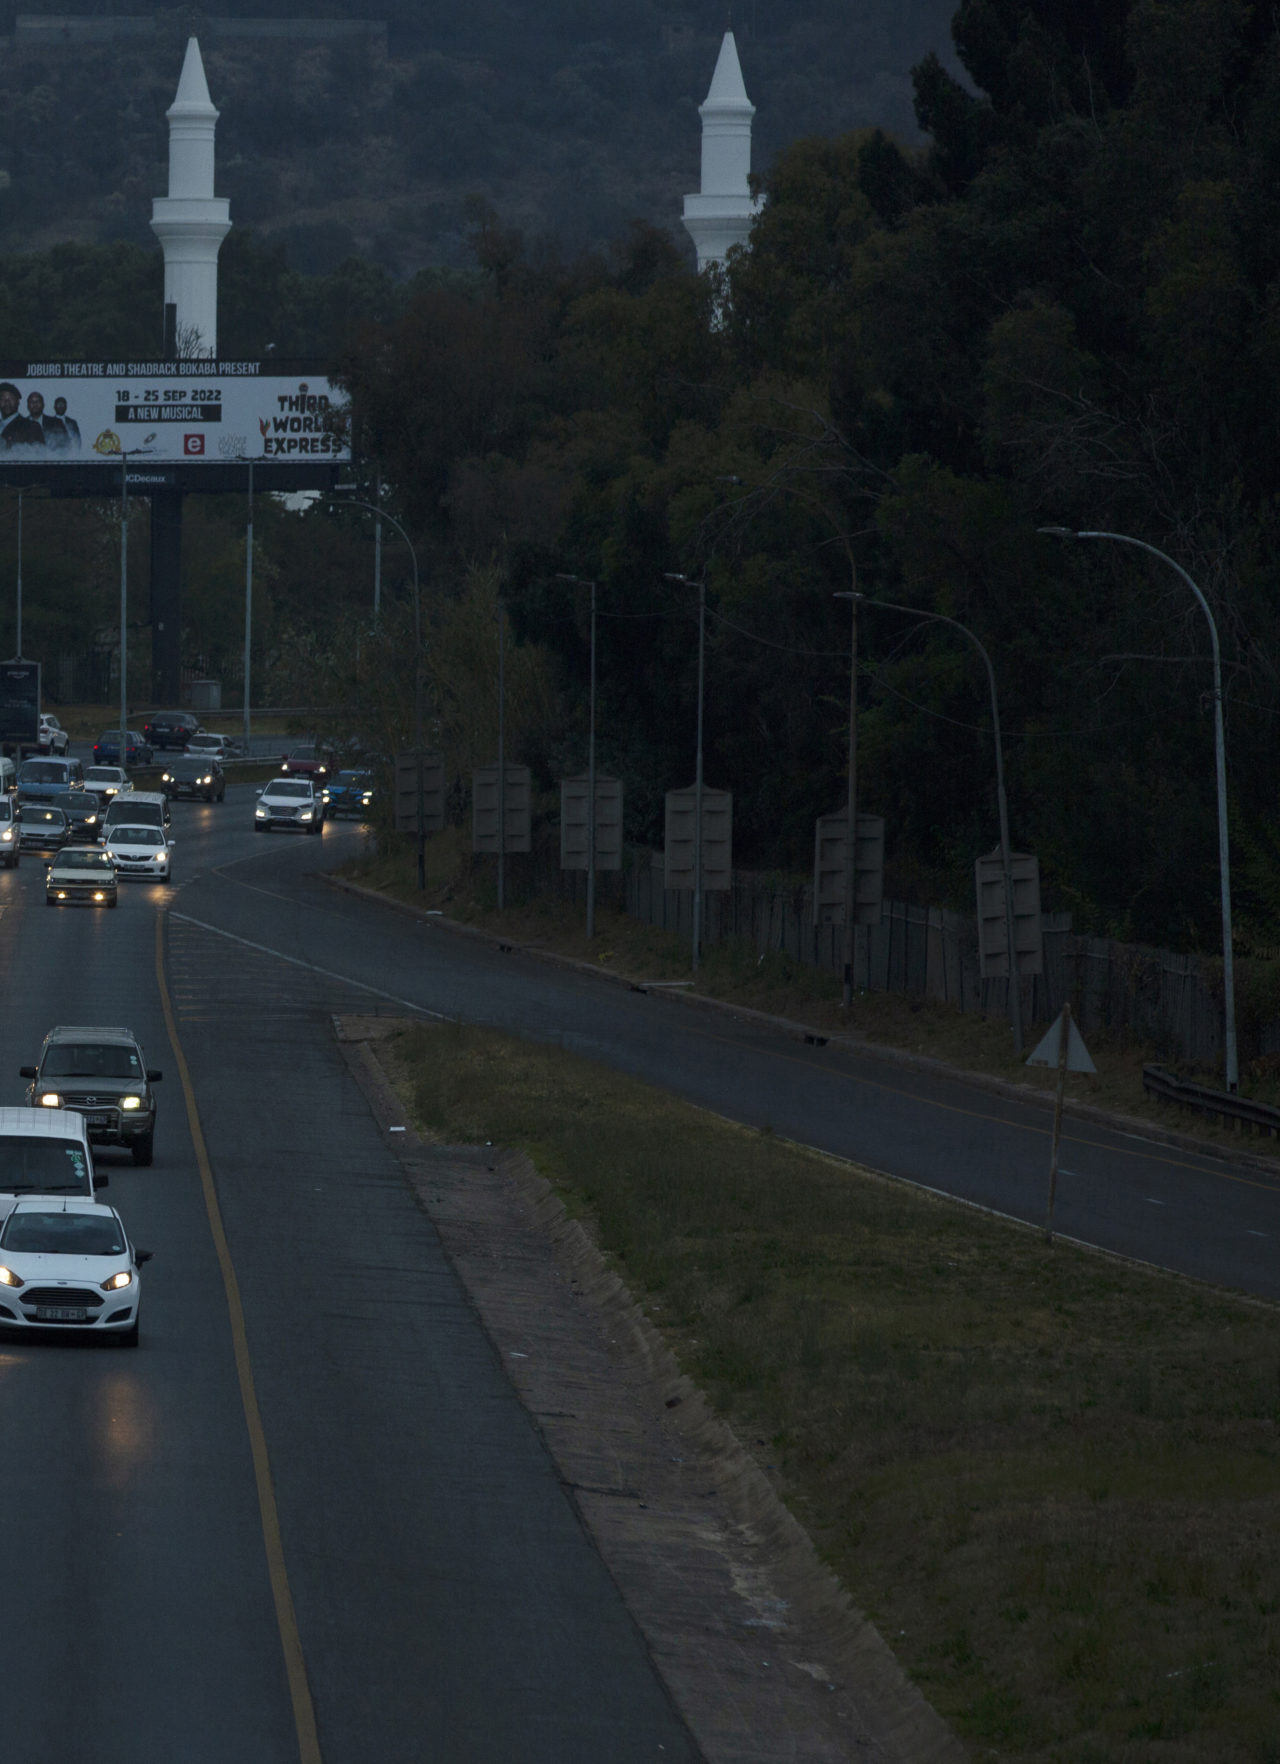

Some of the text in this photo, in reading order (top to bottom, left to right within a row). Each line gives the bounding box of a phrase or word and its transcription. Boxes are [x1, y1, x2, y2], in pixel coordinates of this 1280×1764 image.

[26, 362, 261, 376] JOBURG THEATRE AND SHADRACK BOKABA PRESENT
[116, 390, 129, 402] 18
[143, 390, 159, 402] 25
[163, 390, 186, 402] SEP
[191, 389, 222, 402] 2022
[277, 394, 329, 414] THIRD
[128, 406, 204, 420] A NEW MUSICAL
[264, 438, 343, 455] EXPRESS
